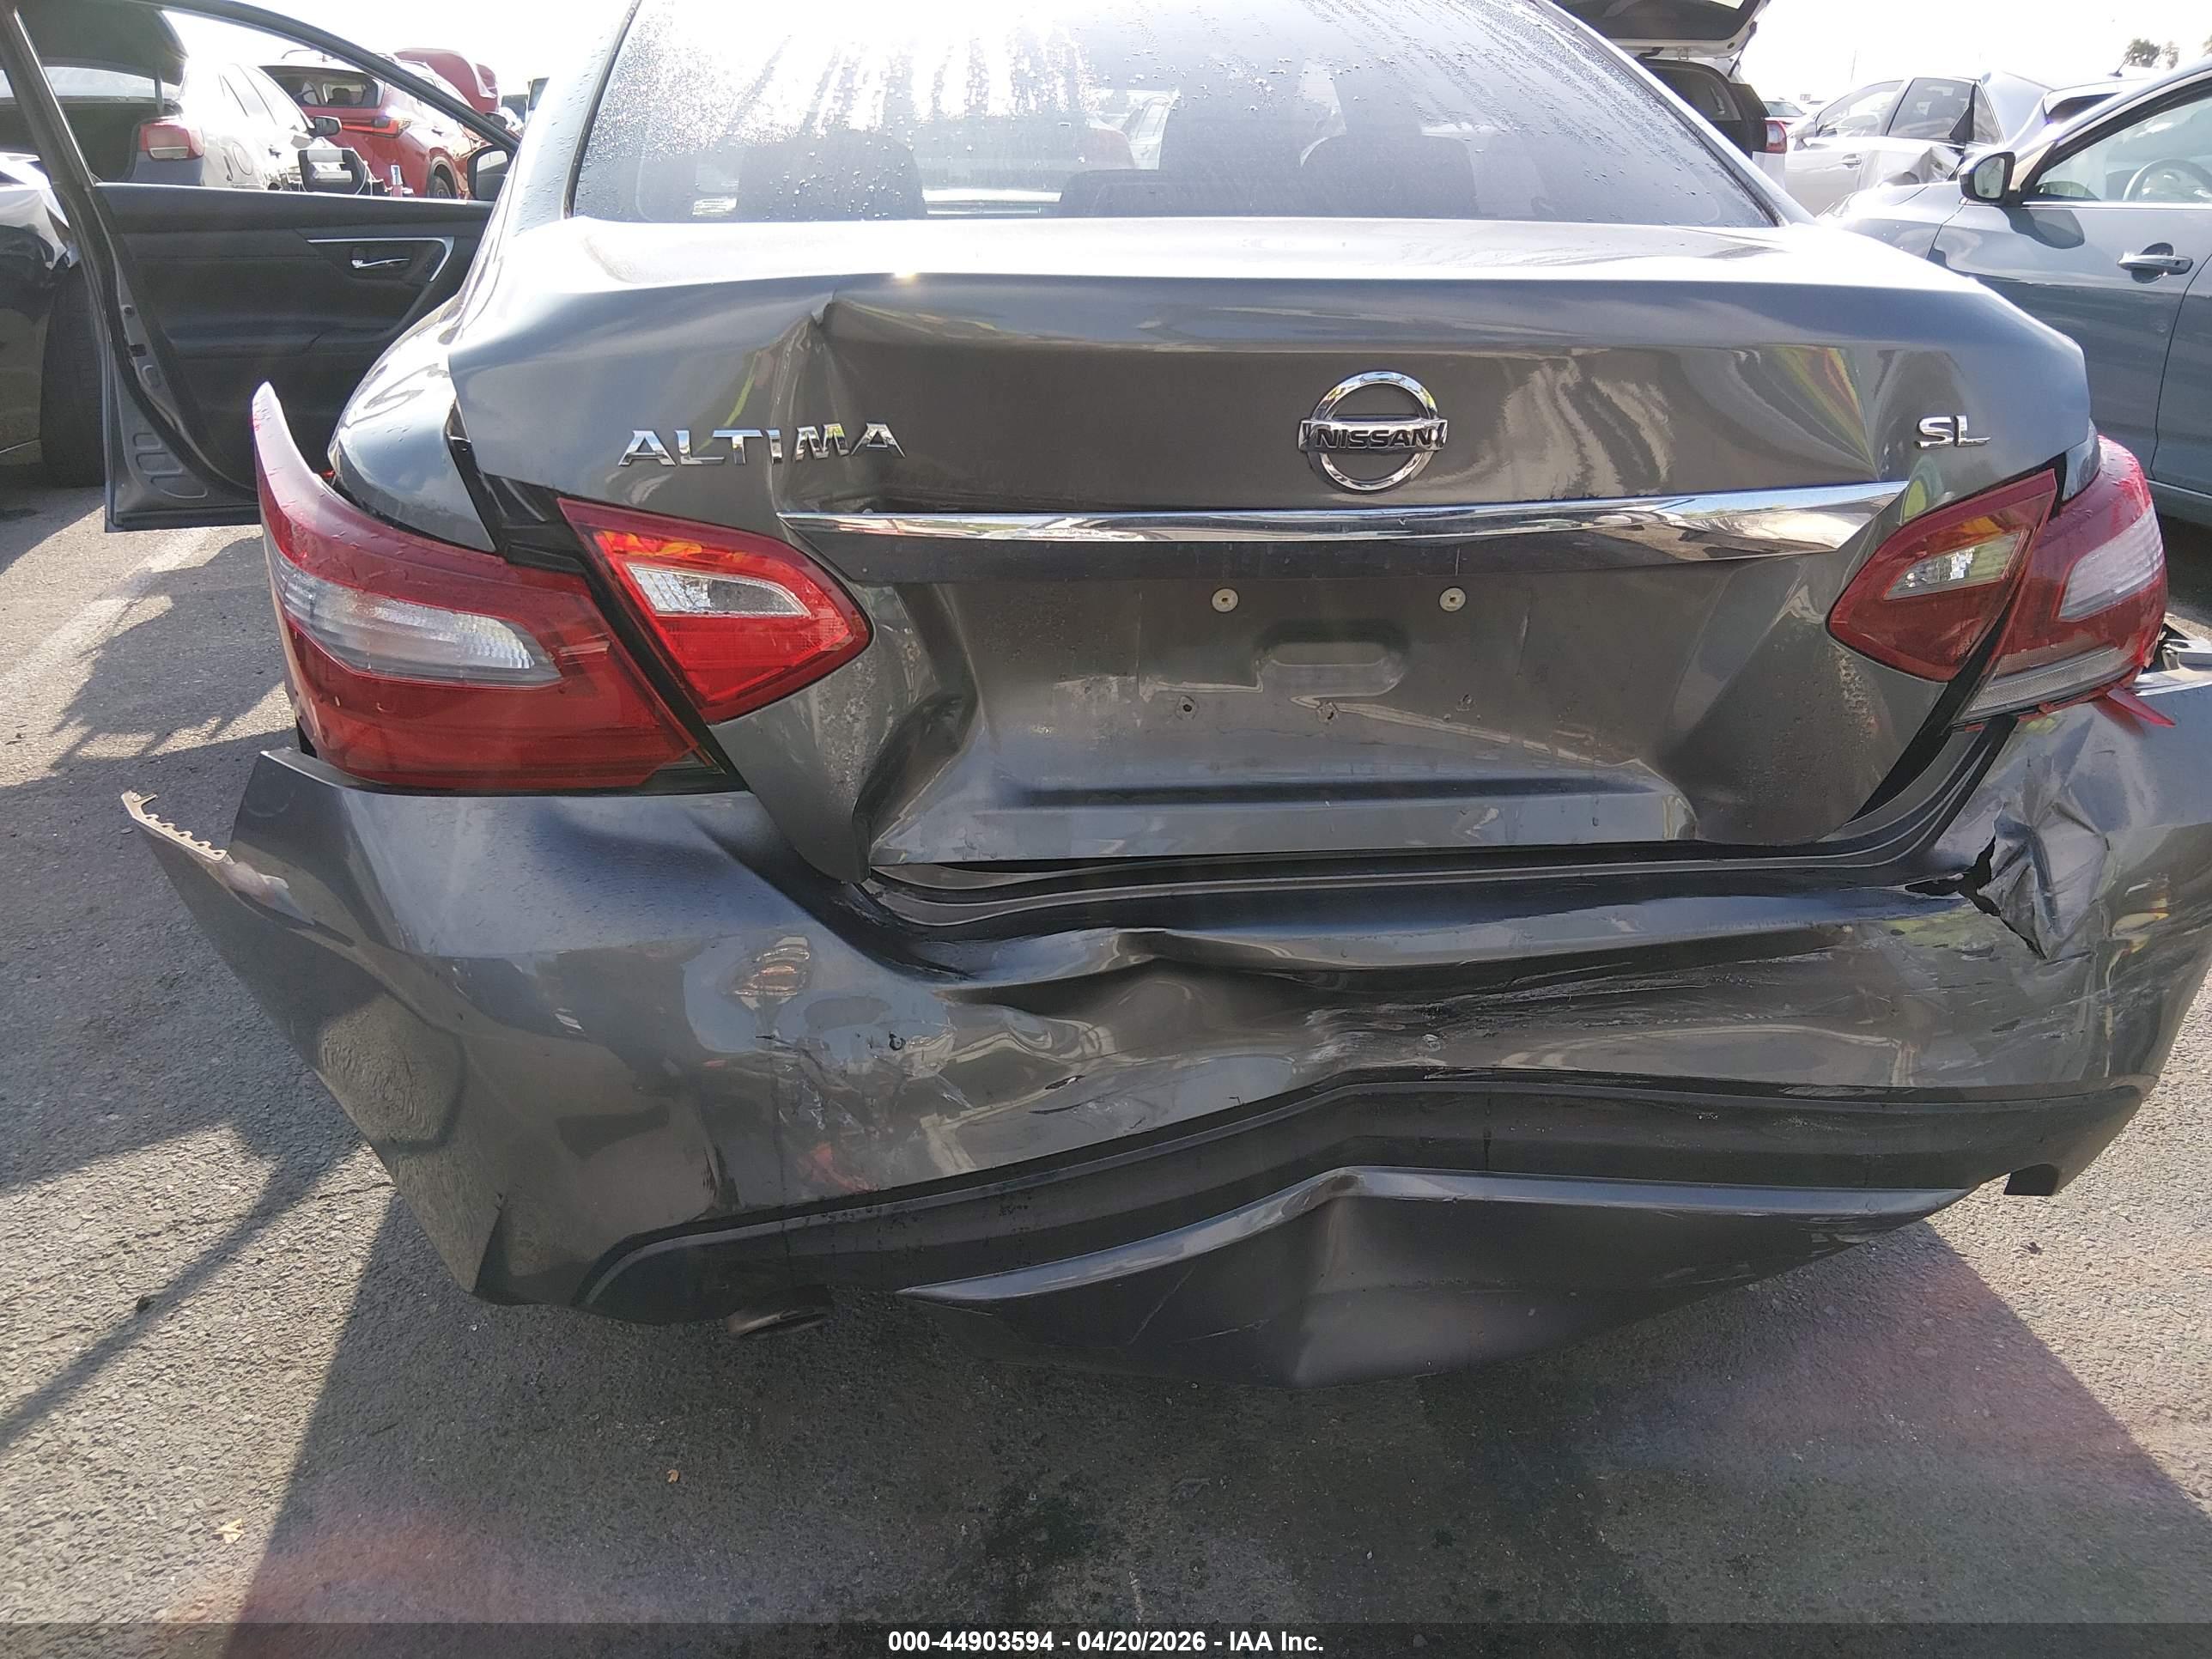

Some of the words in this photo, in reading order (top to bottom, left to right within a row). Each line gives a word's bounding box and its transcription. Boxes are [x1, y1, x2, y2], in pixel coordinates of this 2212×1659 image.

[617, 422, 906, 467] ALTIMA
[1314, 428, 1436, 450] NISSAN
[1915, 416, 1991, 448] SL
